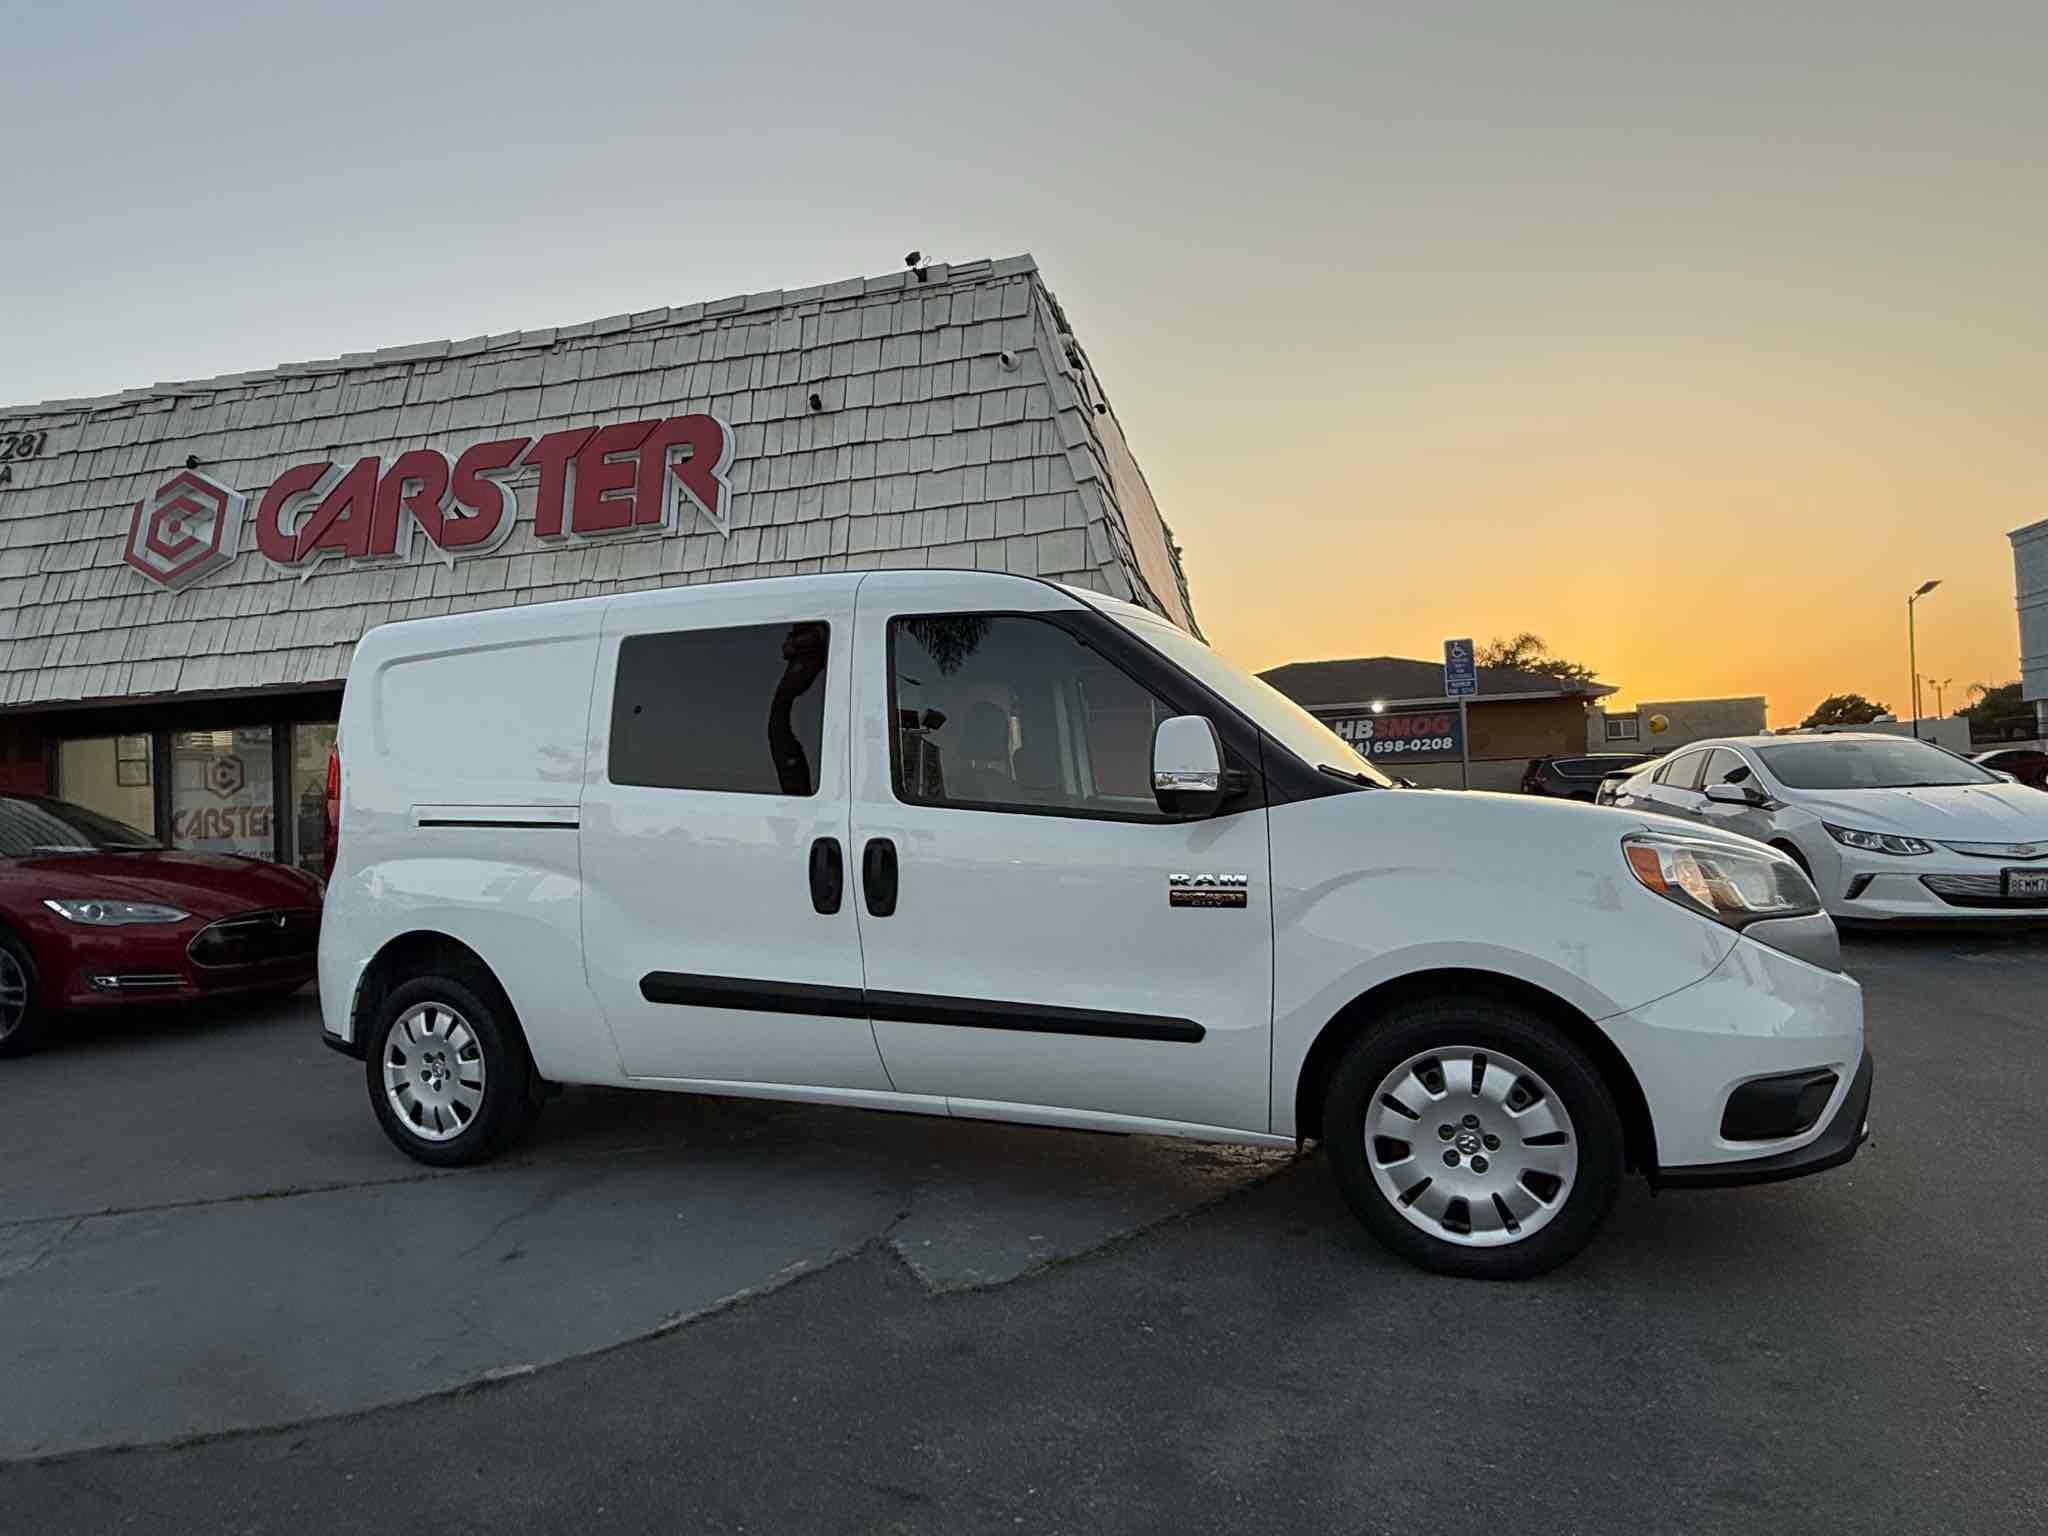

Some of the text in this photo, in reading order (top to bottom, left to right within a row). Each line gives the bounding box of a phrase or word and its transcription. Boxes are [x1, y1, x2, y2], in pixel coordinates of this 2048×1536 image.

[0, 432, 48, 459] 281
[255, 413, 732, 577] CARSTER
[1373, 737, 1453, 753] 698-0208
[1169, 873, 1247, 887] RAM
